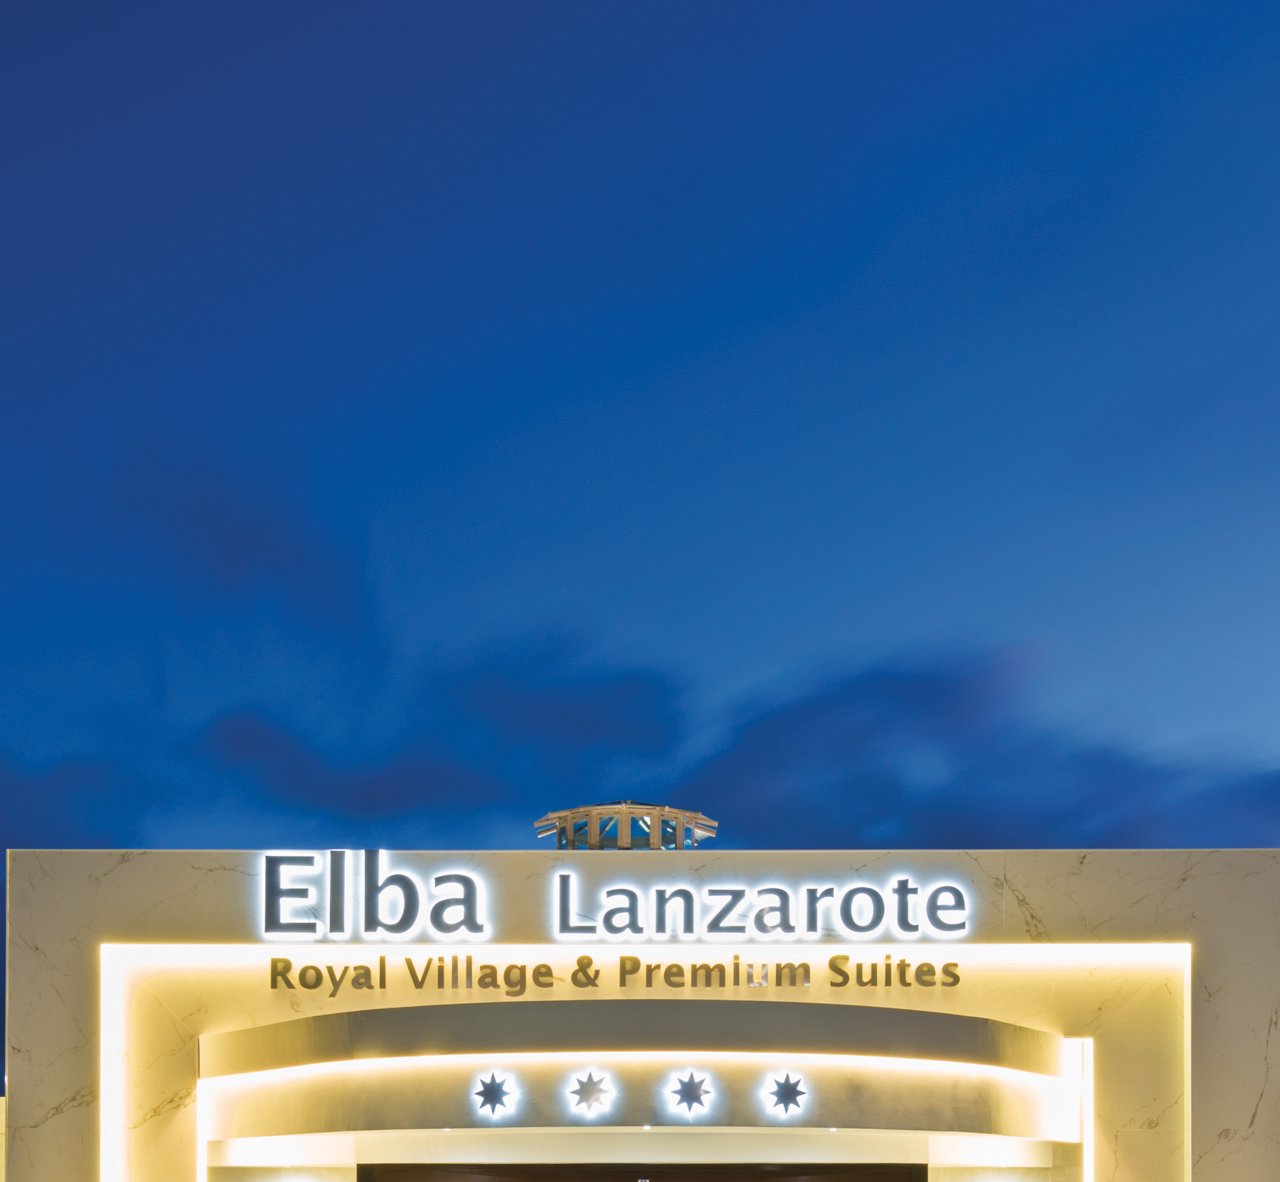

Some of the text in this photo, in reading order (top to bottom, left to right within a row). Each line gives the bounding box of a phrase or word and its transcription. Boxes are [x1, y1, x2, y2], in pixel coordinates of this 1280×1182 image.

[265, 850, 967, 934] Elba Lanzarote
[270, 954, 961, 997] Royal Village & Premium Suites
